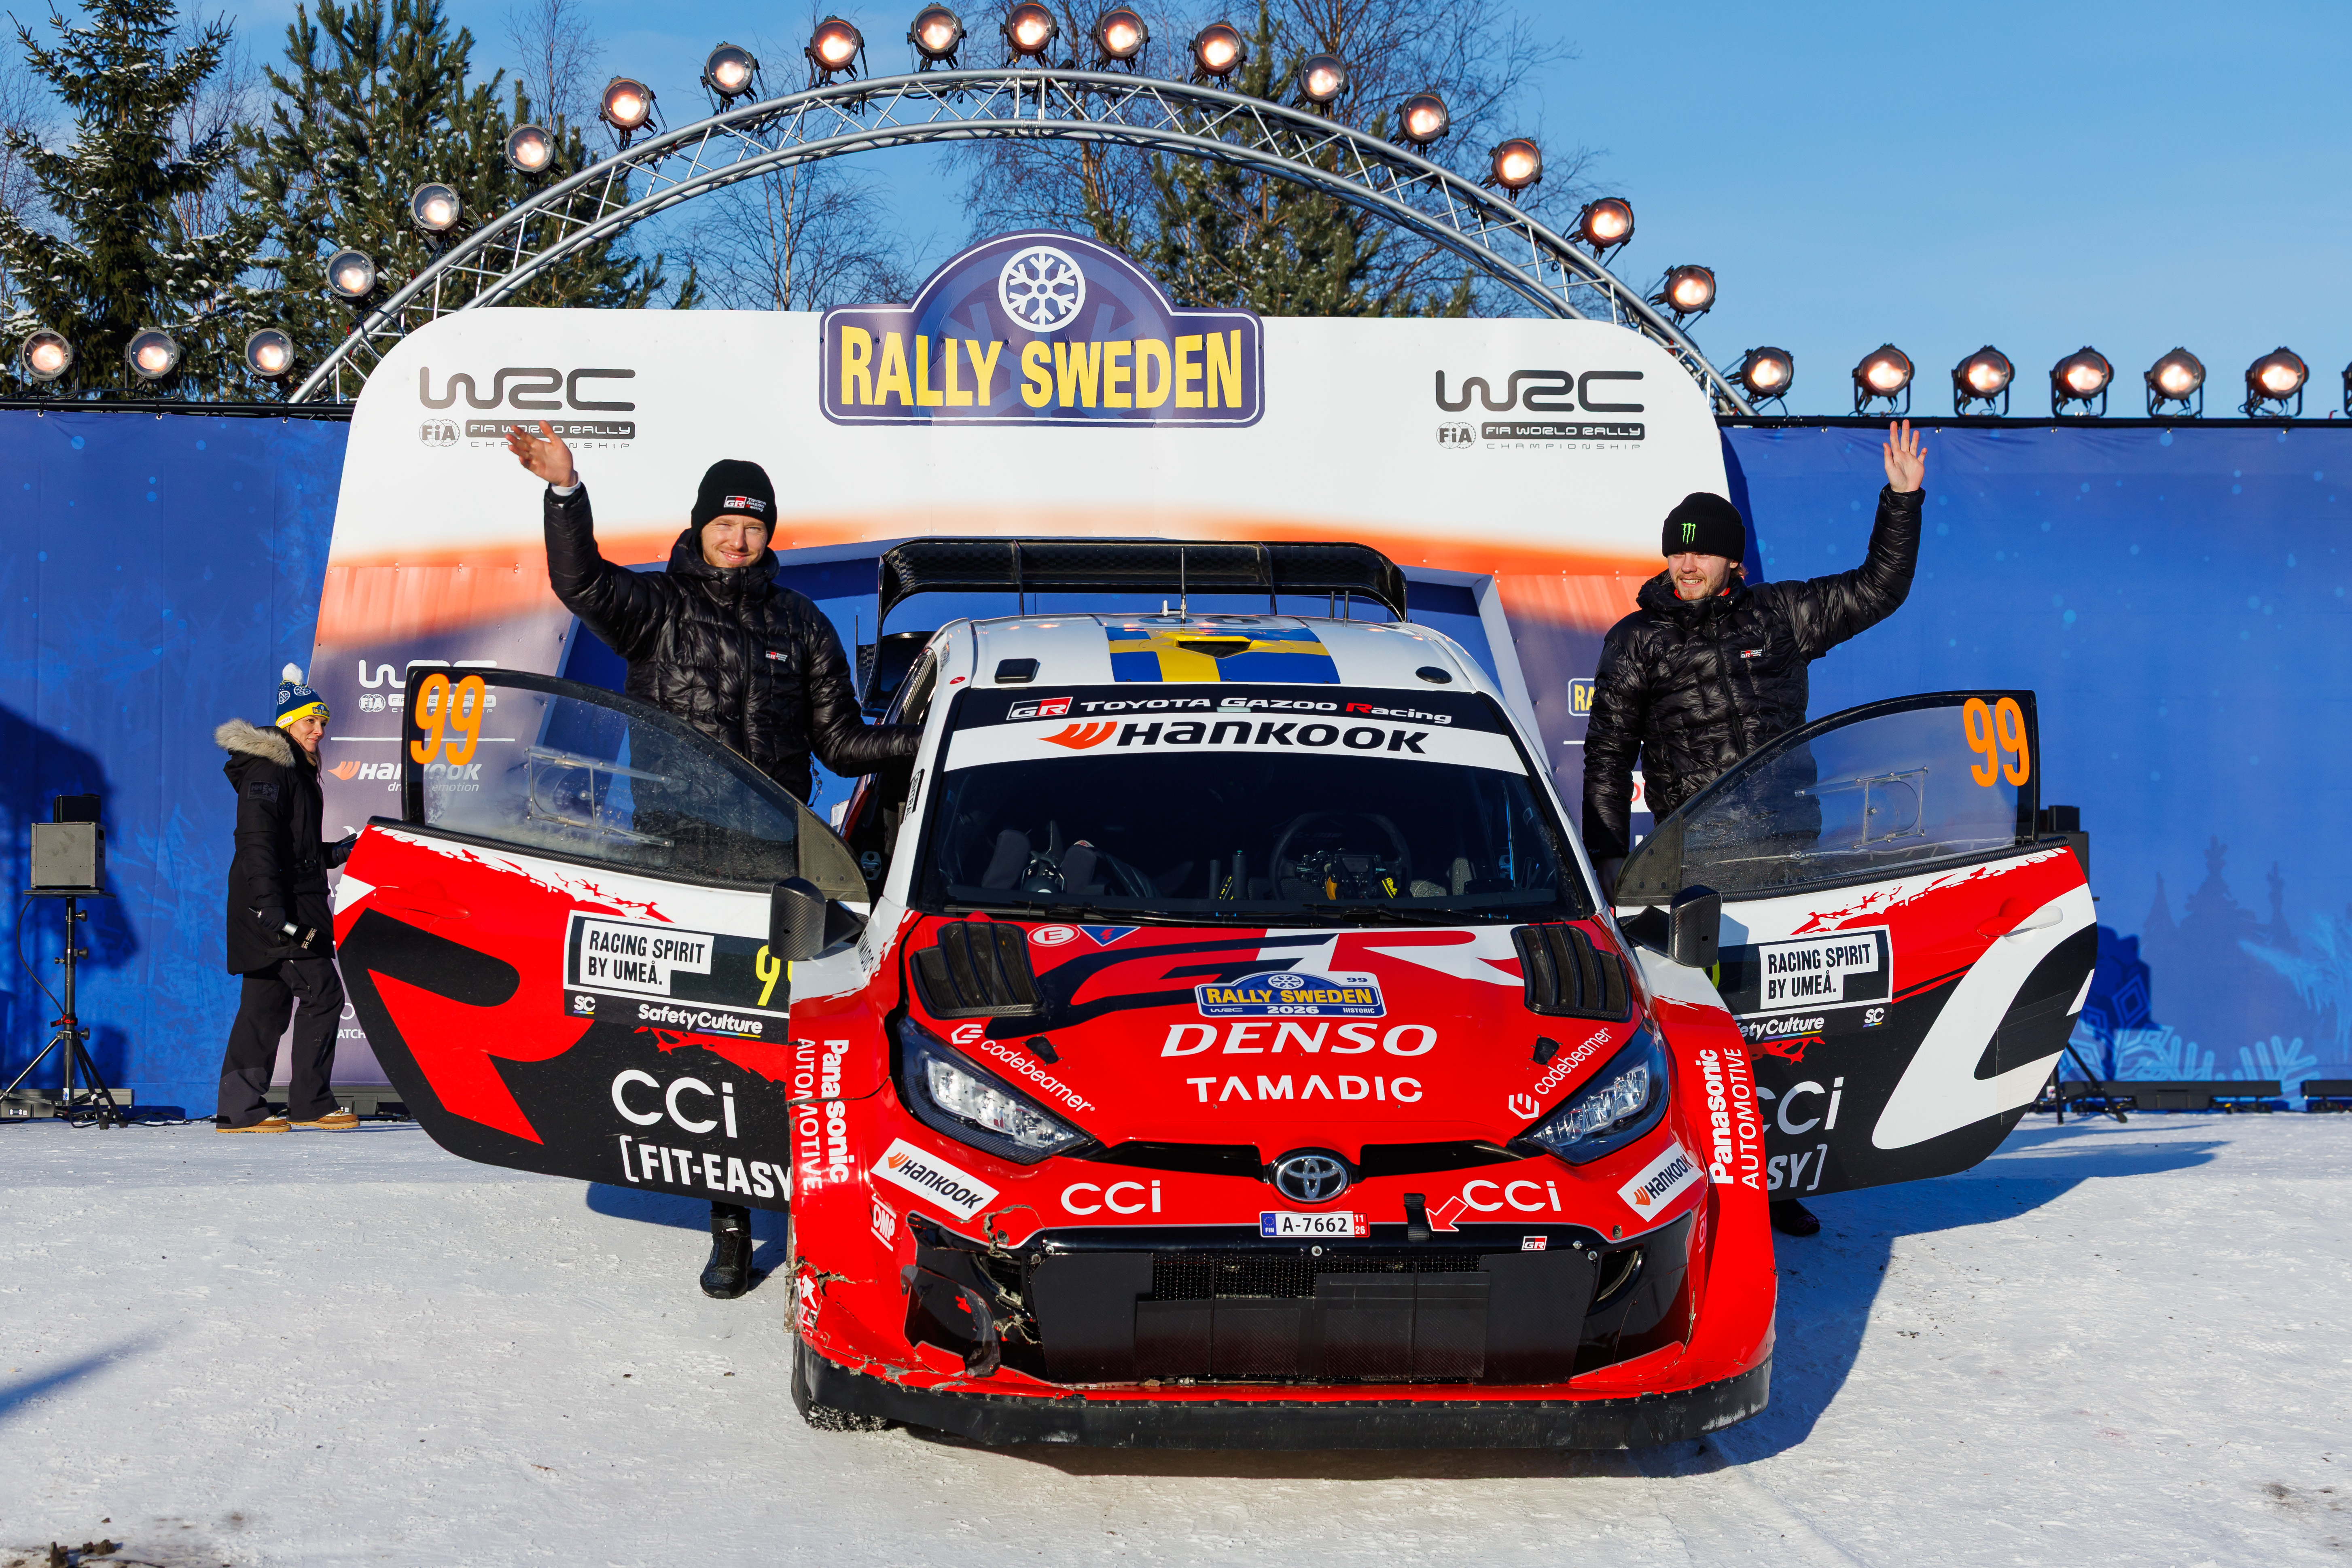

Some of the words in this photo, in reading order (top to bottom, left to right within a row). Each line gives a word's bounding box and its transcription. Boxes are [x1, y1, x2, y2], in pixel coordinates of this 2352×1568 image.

[841, 325, 1002, 407] RALLY
[1021, 330, 1242, 409] SWEDEN
[420, 366, 636, 411] WRC
[1435, 370, 1644, 413] WRC
[470, 424, 496, 433] FIA
[502, 424, 564, 434] WORD
[570, 426, 631, 435] RALLY
[1486, 426, 1511, 435] FIA
[1516, 426, 1577, 435] WORLD
[1582, 427, 1640, 436] RALLY
[470, 441, 630, 449] CHANSHIP
[748, 498, 767, 506] TOYOTA
[278, 717, 292, 726] TOYOTA
[410, 673, 485, 765] 99
[1011, 704, 1067, 718] GR
[1080, 698, 1211, 711] TOYOTA
[1220, 697, 1337, 710] GAZOO
[1345, 702, 1452, 724] Racing
[1963, 697, 2030, 787] 99
[431, 782, 479, 792] emotion
[589, 930, 648, 958] RACING
[652, 938, 705, 964] SPIRIT
[1767, 949, 1821, 975] RACING
[1825, 943, 1871, 968] SPIRIT
[588, 956, 608, 977] BY
[613, 960, 663, 985] UMEÅ.
[1768, 978, 1787, 1000] BY
[1791, 970, 1837, 998] UMEÅ.
[574, 995, 596, 1012] SC
[1206, 988, 1272, 1003] RALLY
[1281, 988, 1373, 1004] SWEDEN
[1267, 1006, 1320, 1015] 2026
[638, 1004, 763, 1034] SafetyCulture
[1737, 1017, 1825, 1041] etyCulture
[1864, 1007, 1884, 1024] SC
[337, 1029, 366, 1039] ATCH
[1160, 1022, 1437, 1057] DENSO
[981, 1040, 1092, 1112] codebeamer
[1534, 1029, 1612, 1095] codebeamer
[1187, 1075, 1423, 1102] TAMADIC
[794, 1038, 823, 1191] AUTOMOTIVE
[821, 1039, 855, 1183] Panasonic
[1695, 1049, 1734, 1184] Panasonic
[1723, 1048, 1759, 1190] AUTOMOTIVE
[873, 1204, 895, 1241] OMP
[1282, 1217, 1348, 1232] A-7662
[1354, 1214, 1364, 1223] 11
[1355, 1225, 1366, 1235] 26
